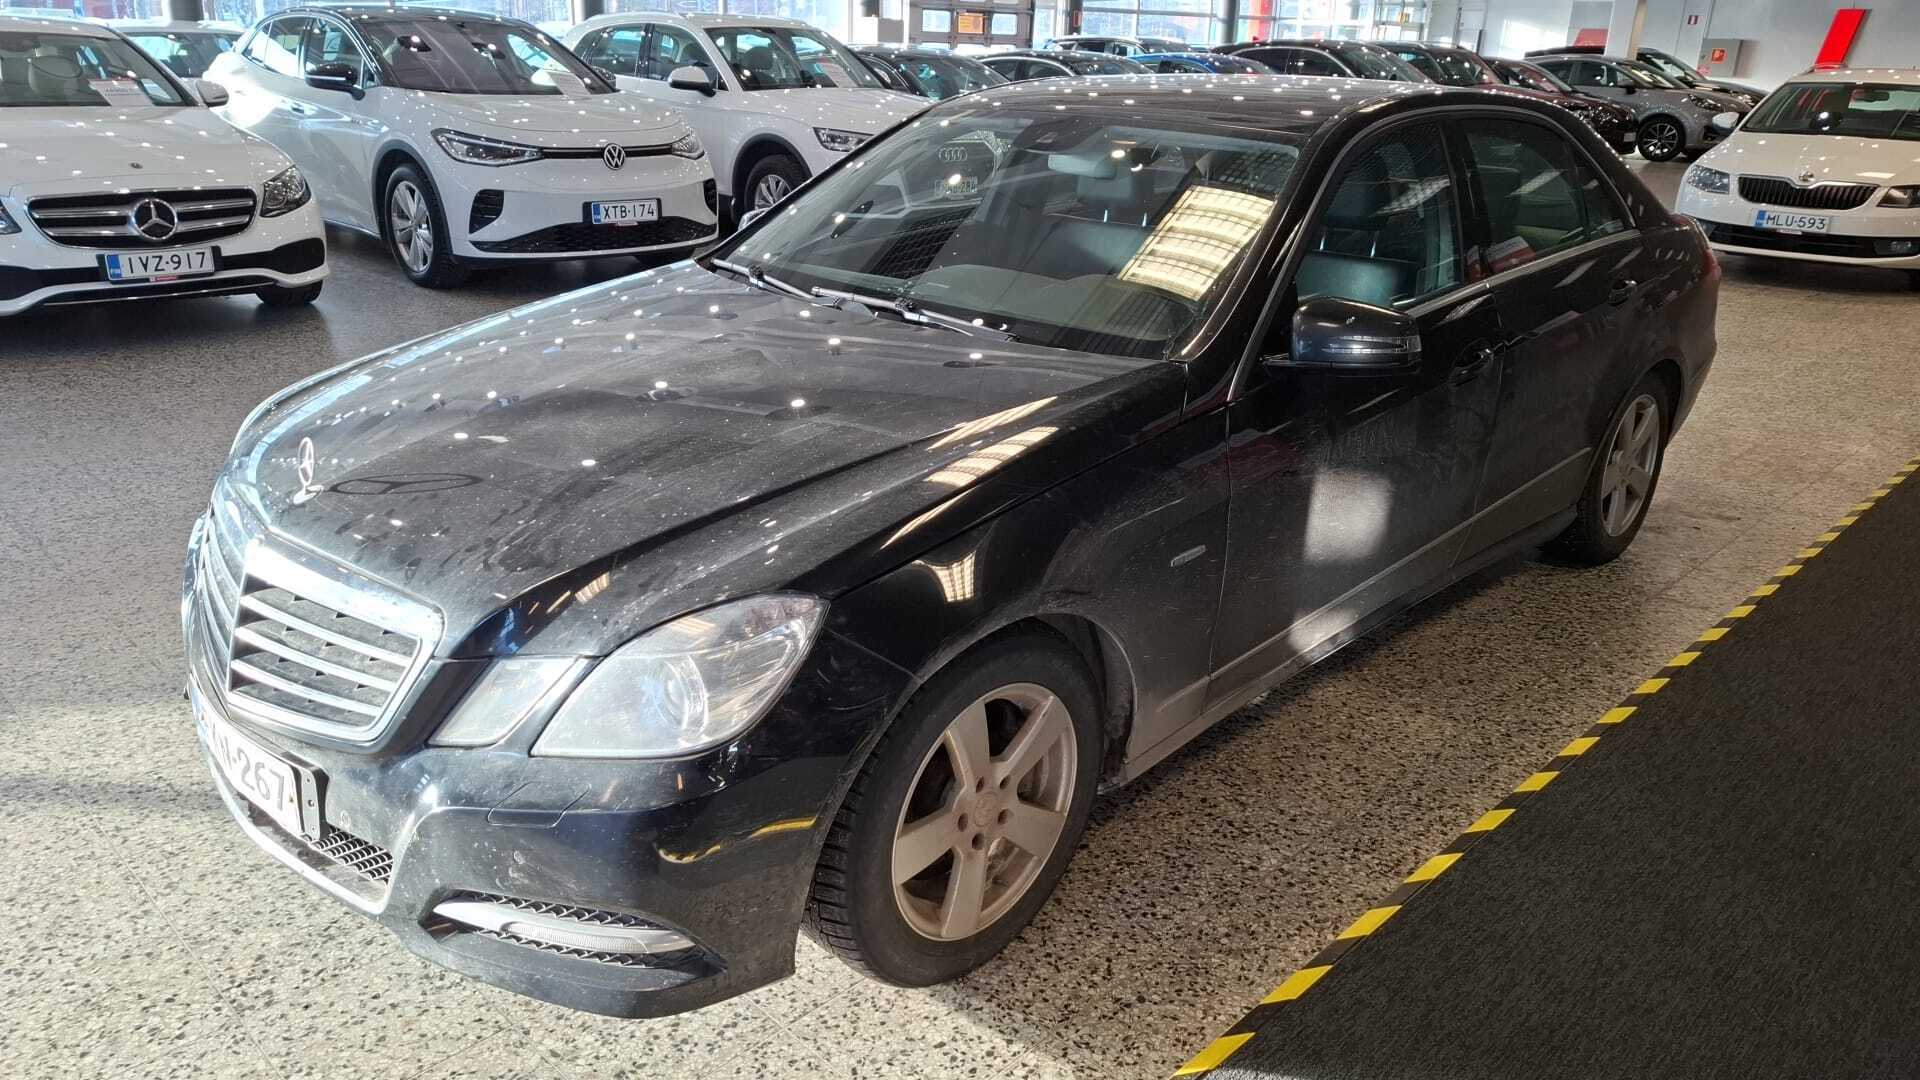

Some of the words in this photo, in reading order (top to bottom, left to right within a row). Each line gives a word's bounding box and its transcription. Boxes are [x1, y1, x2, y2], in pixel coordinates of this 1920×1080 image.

[603, 204, 654, 219] XTB-174
[1766, 214, 1826, 230] MLU-593
[128, 252, 205, 273] IVZ-917
